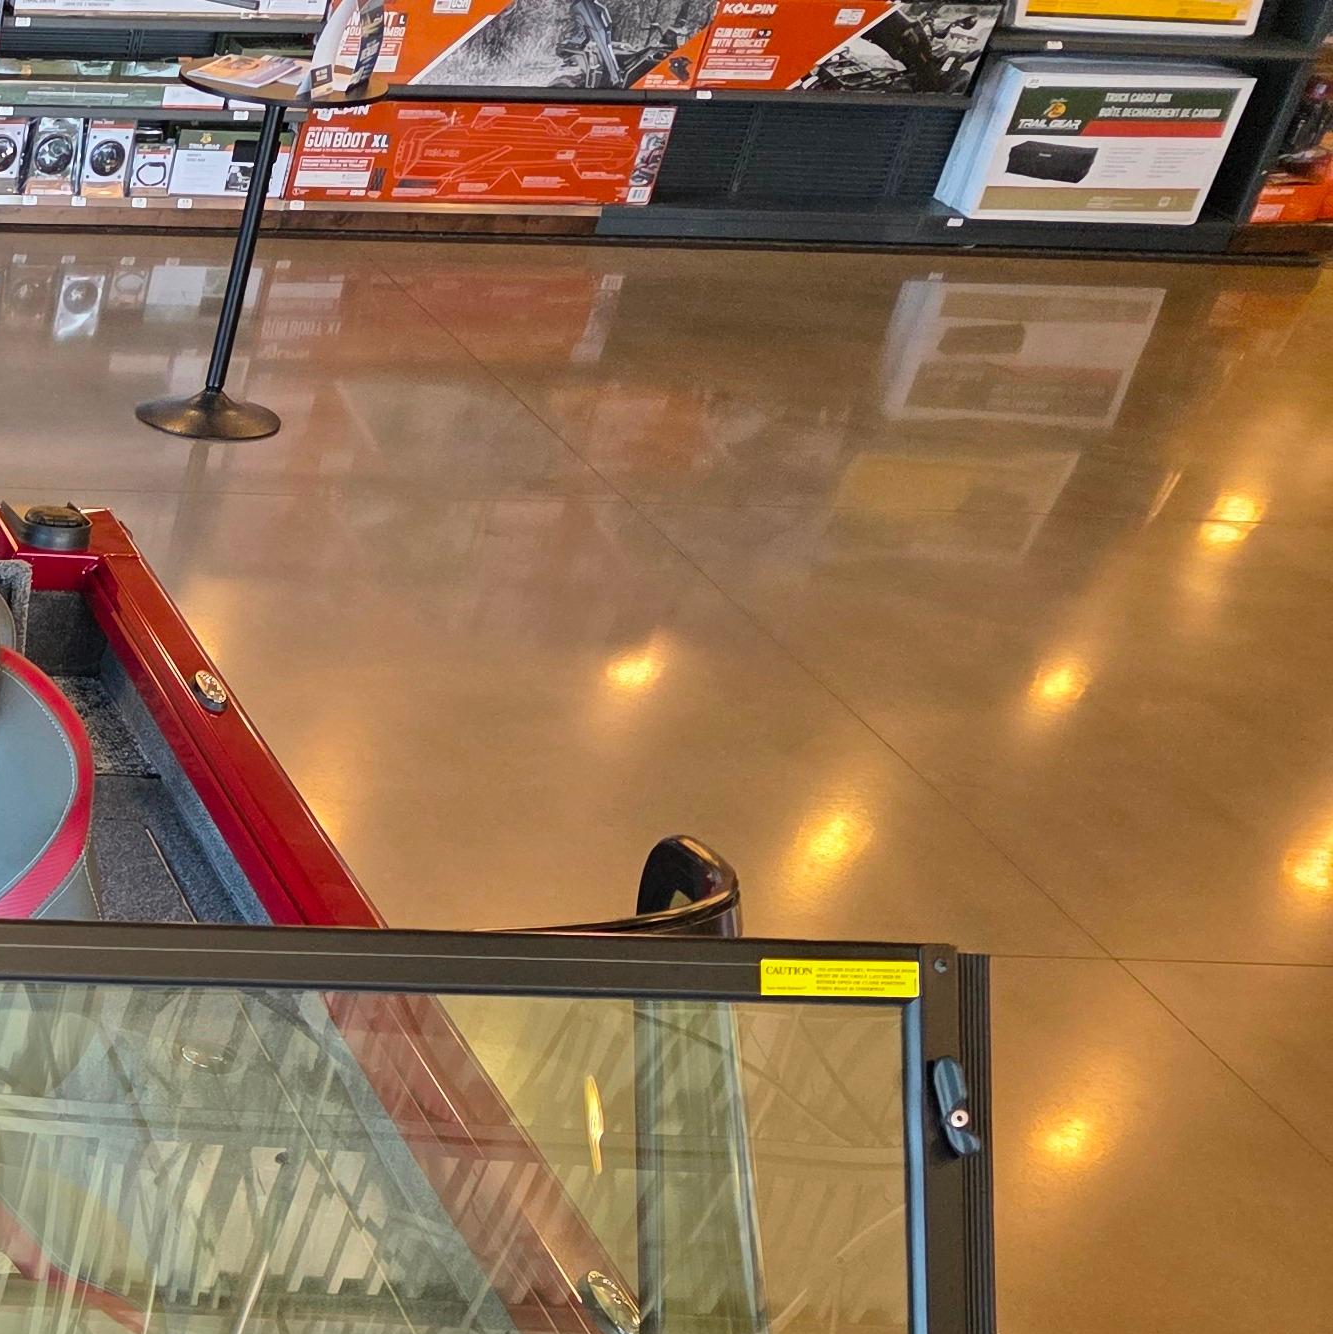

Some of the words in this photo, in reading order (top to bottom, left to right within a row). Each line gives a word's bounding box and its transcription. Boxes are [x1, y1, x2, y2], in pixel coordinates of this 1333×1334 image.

[722, 2, 778, 14] KOLPIN
[1017, 118, 1049, 129] TRAIL
[1049, 118, 1082, 130] GEAR
[371, 134, 389, 148] XL
[765, 965, 813, 976] CAUTION
